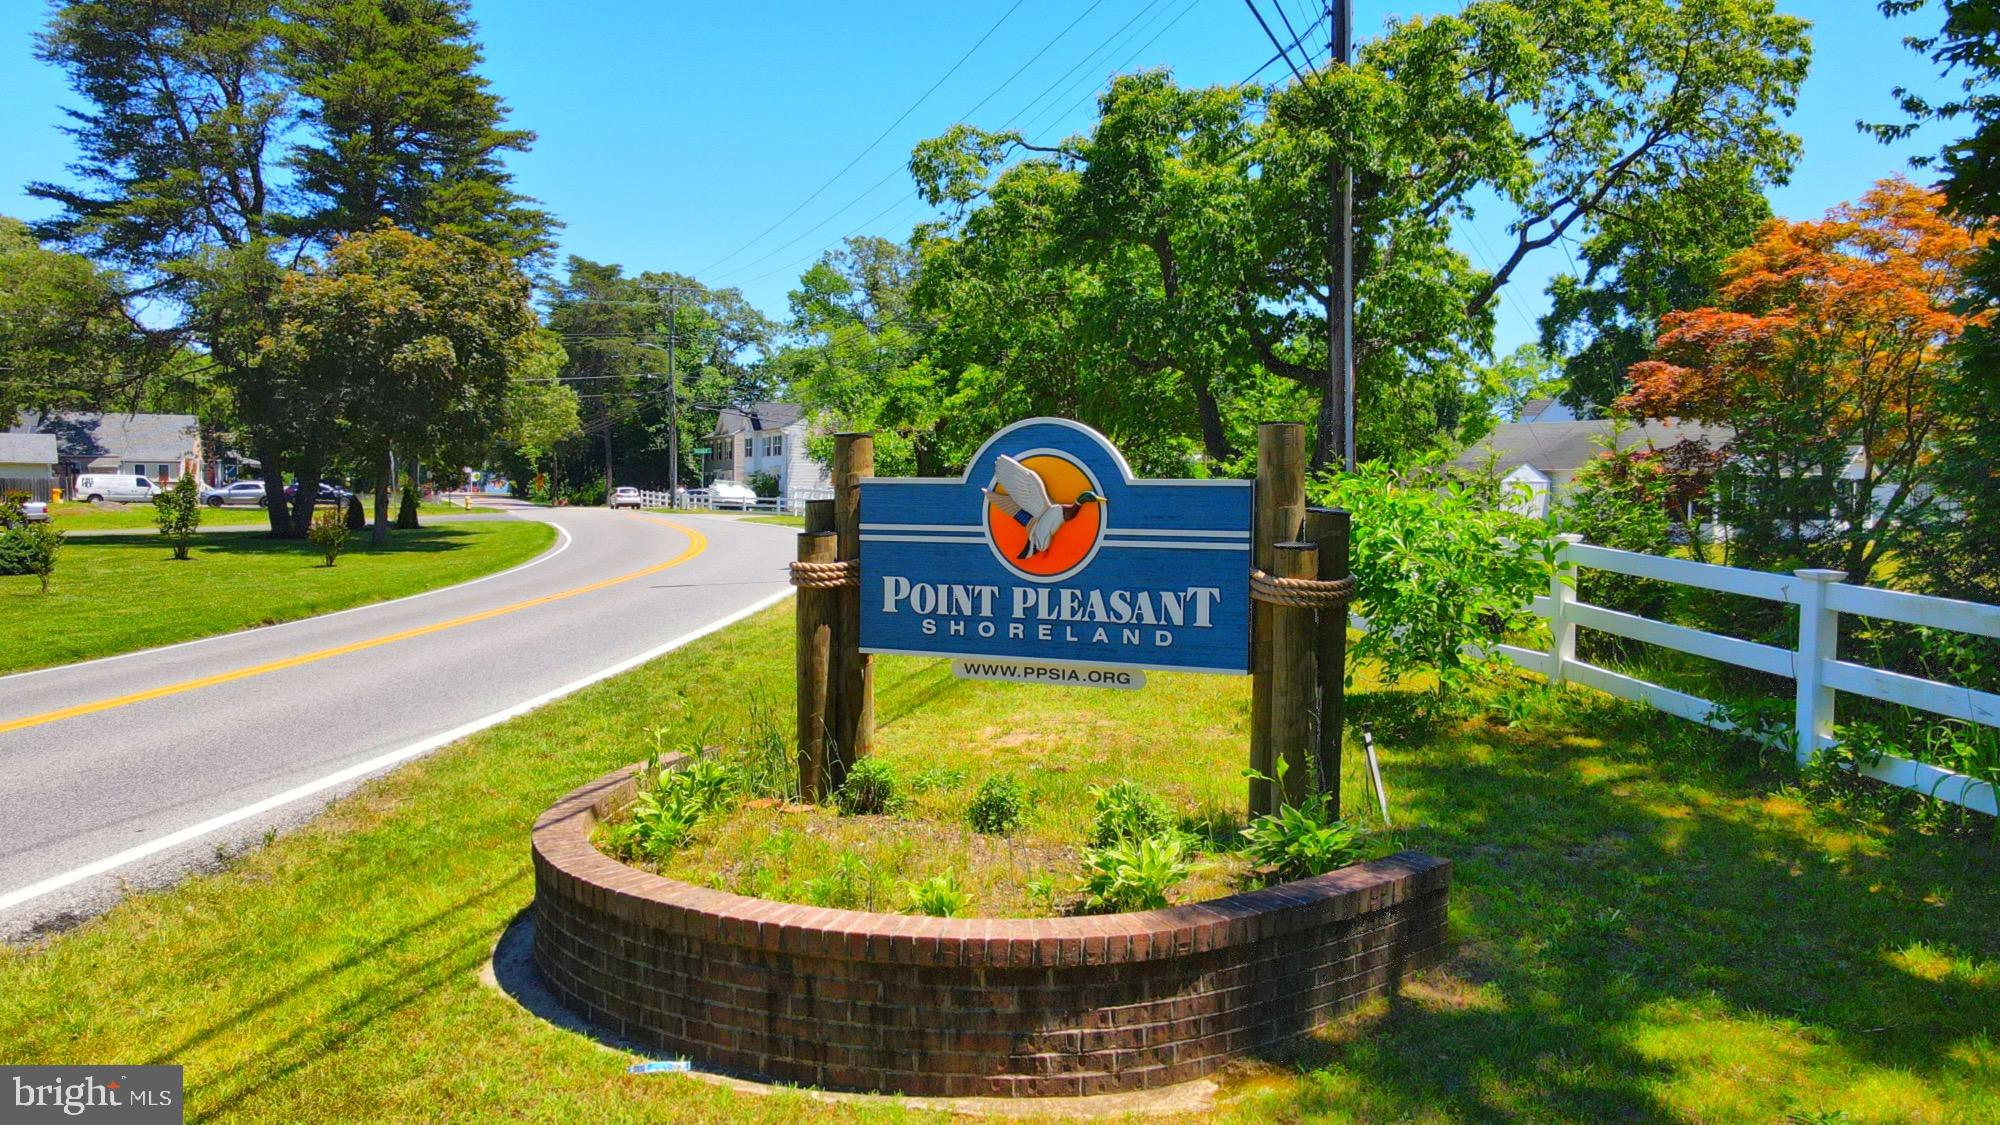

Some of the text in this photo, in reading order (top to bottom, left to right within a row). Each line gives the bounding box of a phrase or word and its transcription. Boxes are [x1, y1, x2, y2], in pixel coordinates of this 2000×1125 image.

[882, 576, 1220, 628] POINT PLEASANT
[921, 619, 1174, 647] SHORELAND
[964, 662, 1132, 685] WWW.PPSIA.ORG
